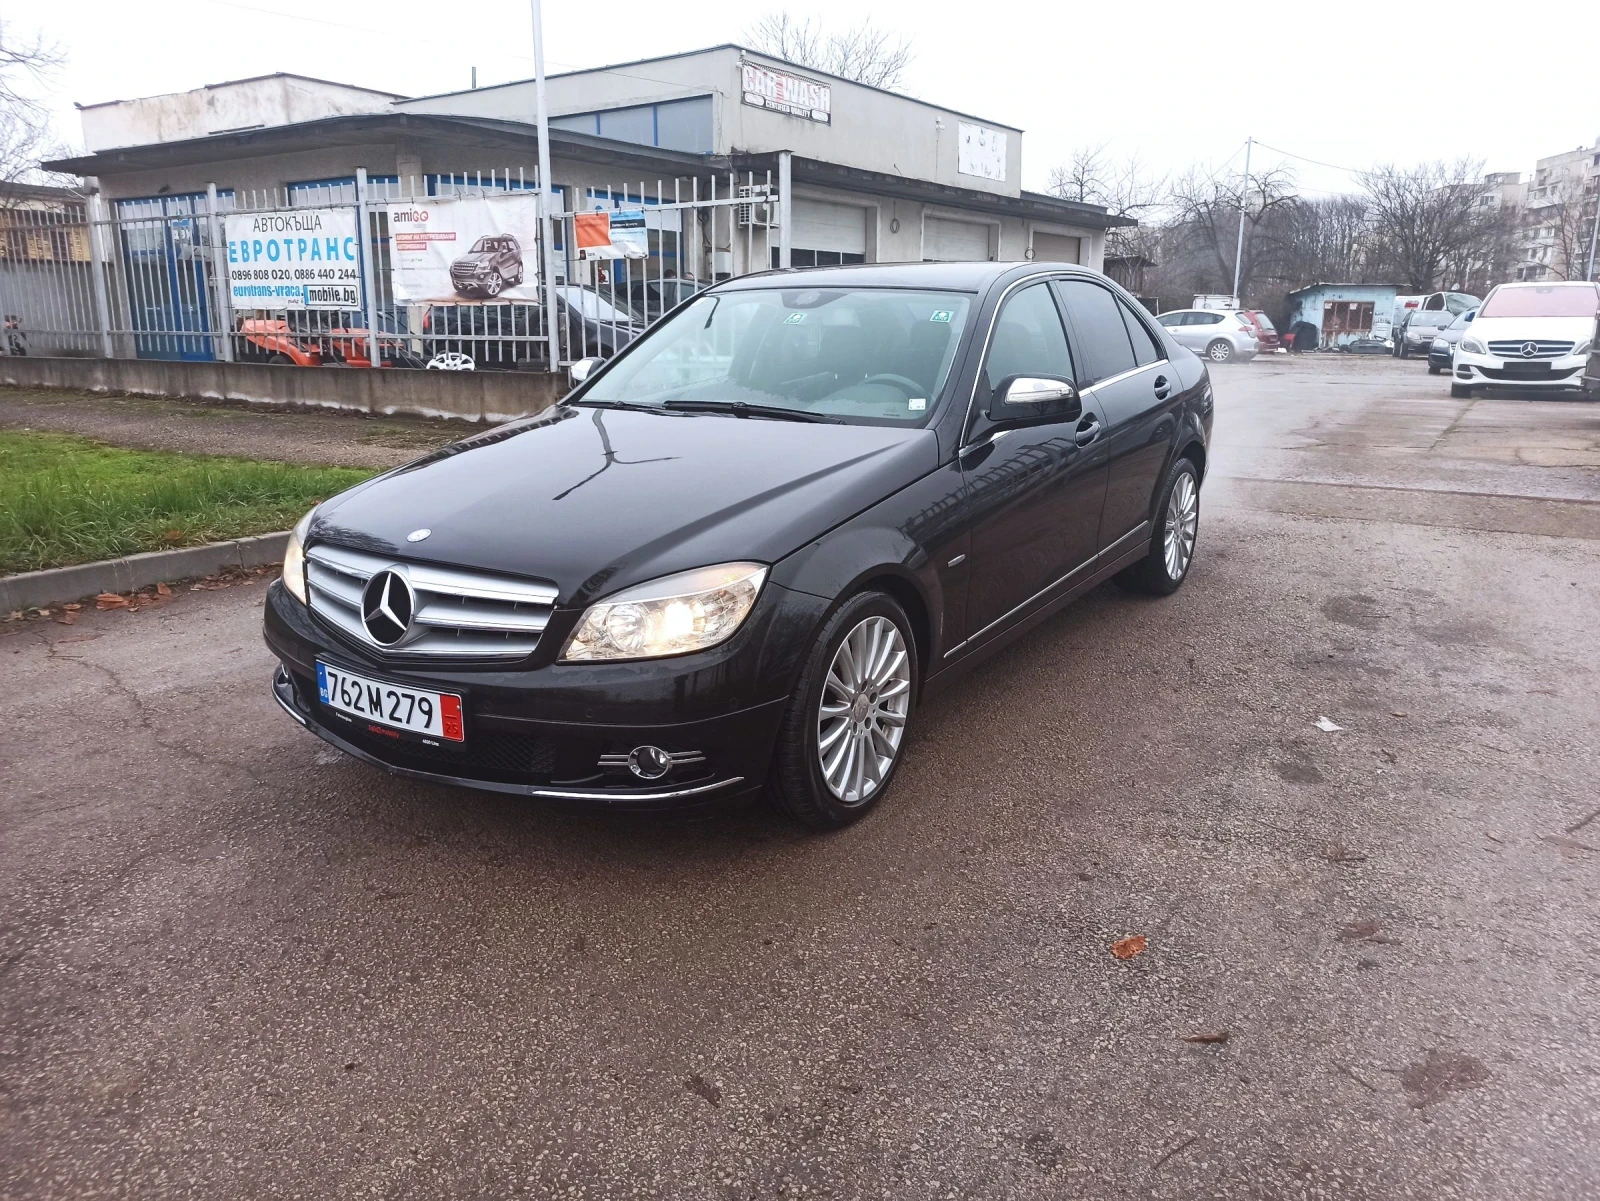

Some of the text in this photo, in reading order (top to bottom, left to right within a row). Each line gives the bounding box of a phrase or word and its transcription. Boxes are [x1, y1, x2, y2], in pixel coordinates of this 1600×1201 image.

[743, 66, 831, 113] CAR WASH
[766, 100, 811, 118] CERTIFIED QUALITY
[253, 215, 322, 233] АВТОКЪЩА
[229, 237, 355, 263] ЕВРОТРАНС
[231, 268, 357, 281] 0896 808 020, 0886 440 244
[319, 687, 329, 698] BG
